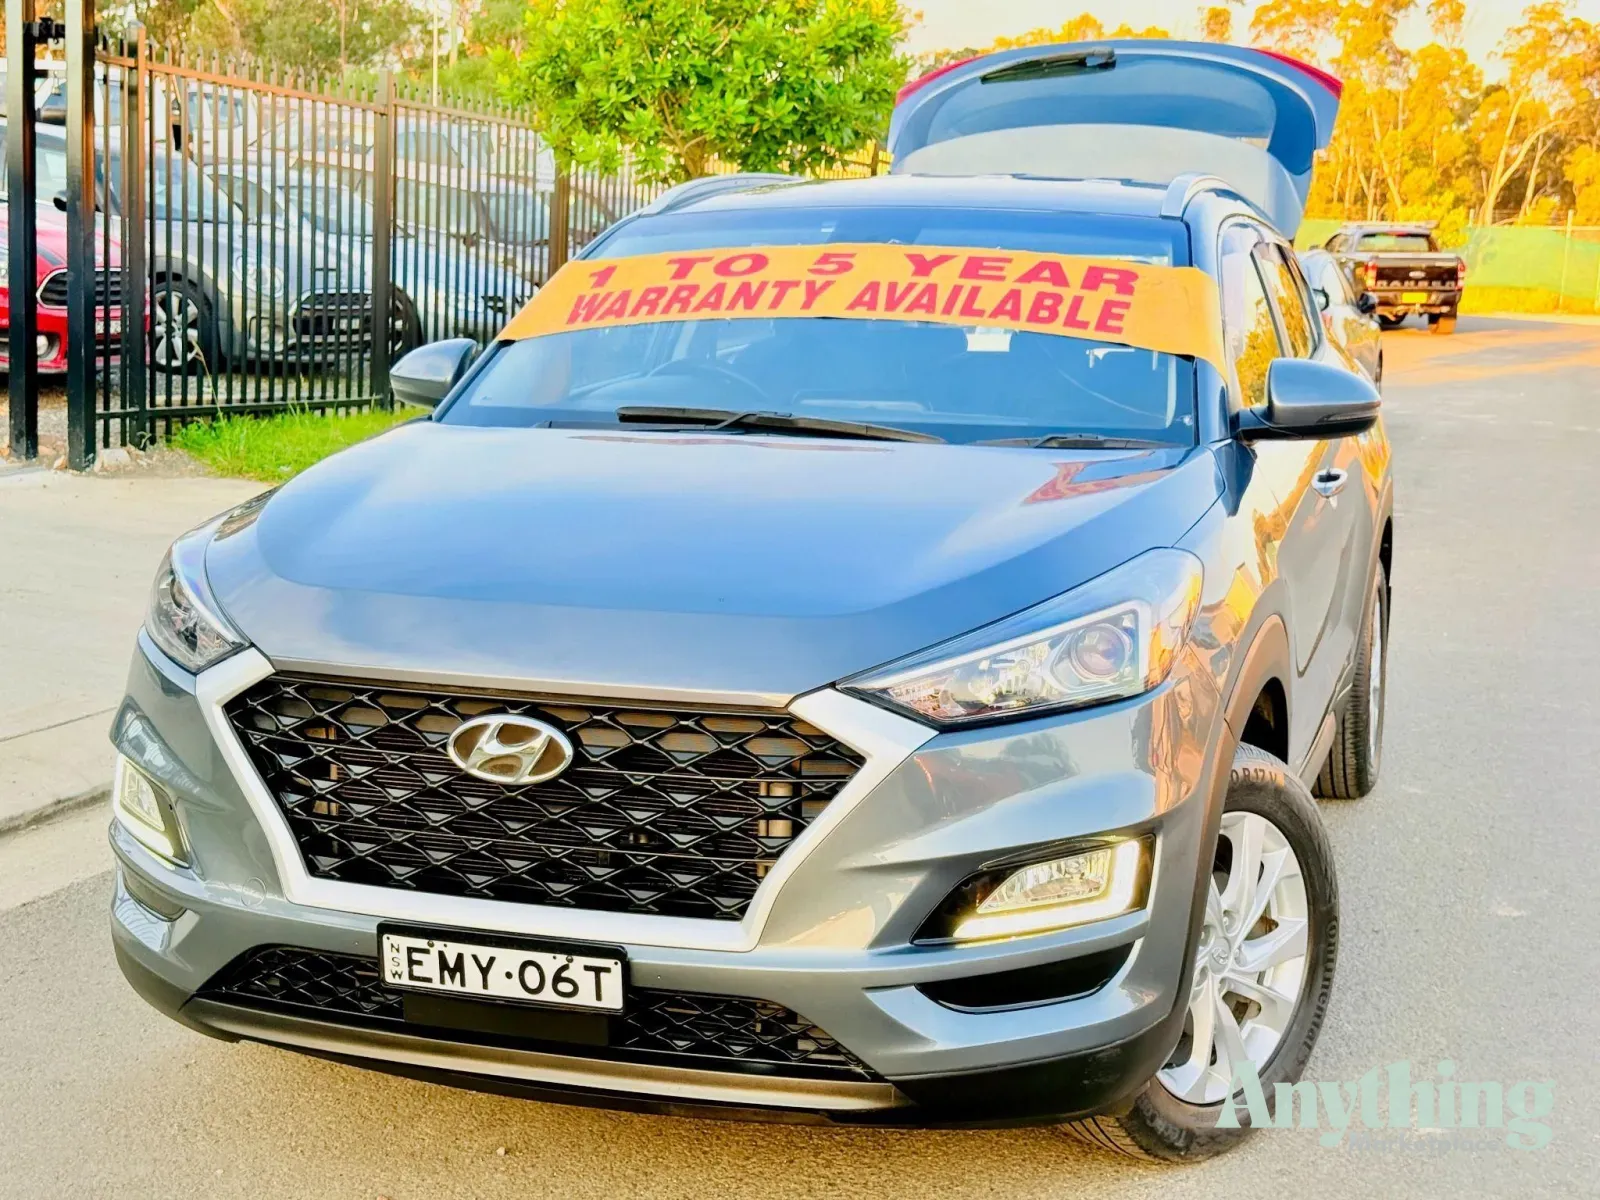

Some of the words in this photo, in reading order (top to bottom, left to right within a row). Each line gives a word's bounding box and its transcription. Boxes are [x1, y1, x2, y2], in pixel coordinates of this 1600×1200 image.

[590, 266, 616, 288] 1
[668, 253, 769, 280] TO
[809, 253, 854, 275] 5
[906, 253, 1139, 296] YEAR
[567, 280, 833, 324] WARRANTY
[846, 281, 1131, 334] AVAILABLE
